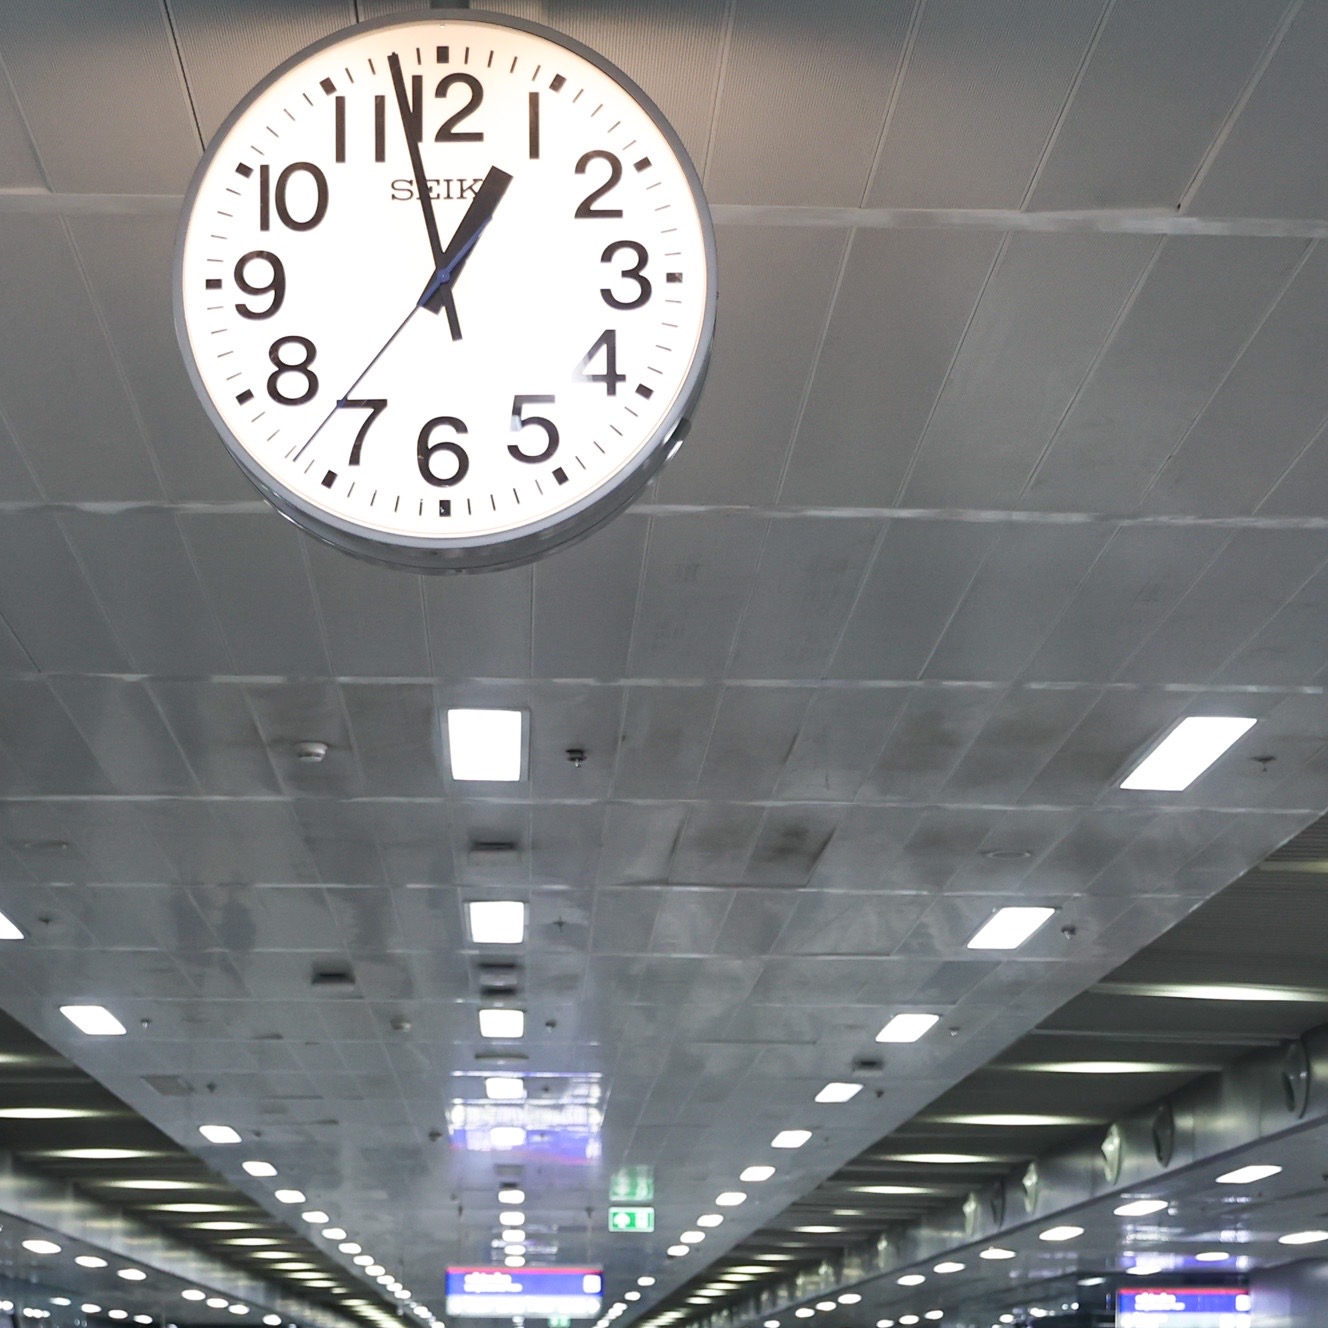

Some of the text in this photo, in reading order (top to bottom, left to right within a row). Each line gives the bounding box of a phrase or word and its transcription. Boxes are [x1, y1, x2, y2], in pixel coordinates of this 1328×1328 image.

[334, 94, 386, 163] 11
[411, 72, 485, 143] 12
[528, 91, 540, 160] 1
[259, 160, 329, 232] 10
[390, 178, 484, 201] SEIK
[573, 149, 624, 219] 2
[233, 249, 287, 321] 9
[599, 239, 653, 311] 3
[266, 334, 320, 406] 8
[573, 328, 627, 397] 4
[336, 397, 388, 466] 7
[416, 415, 470, 488] 6
[506, 393, 560, 464] 5
